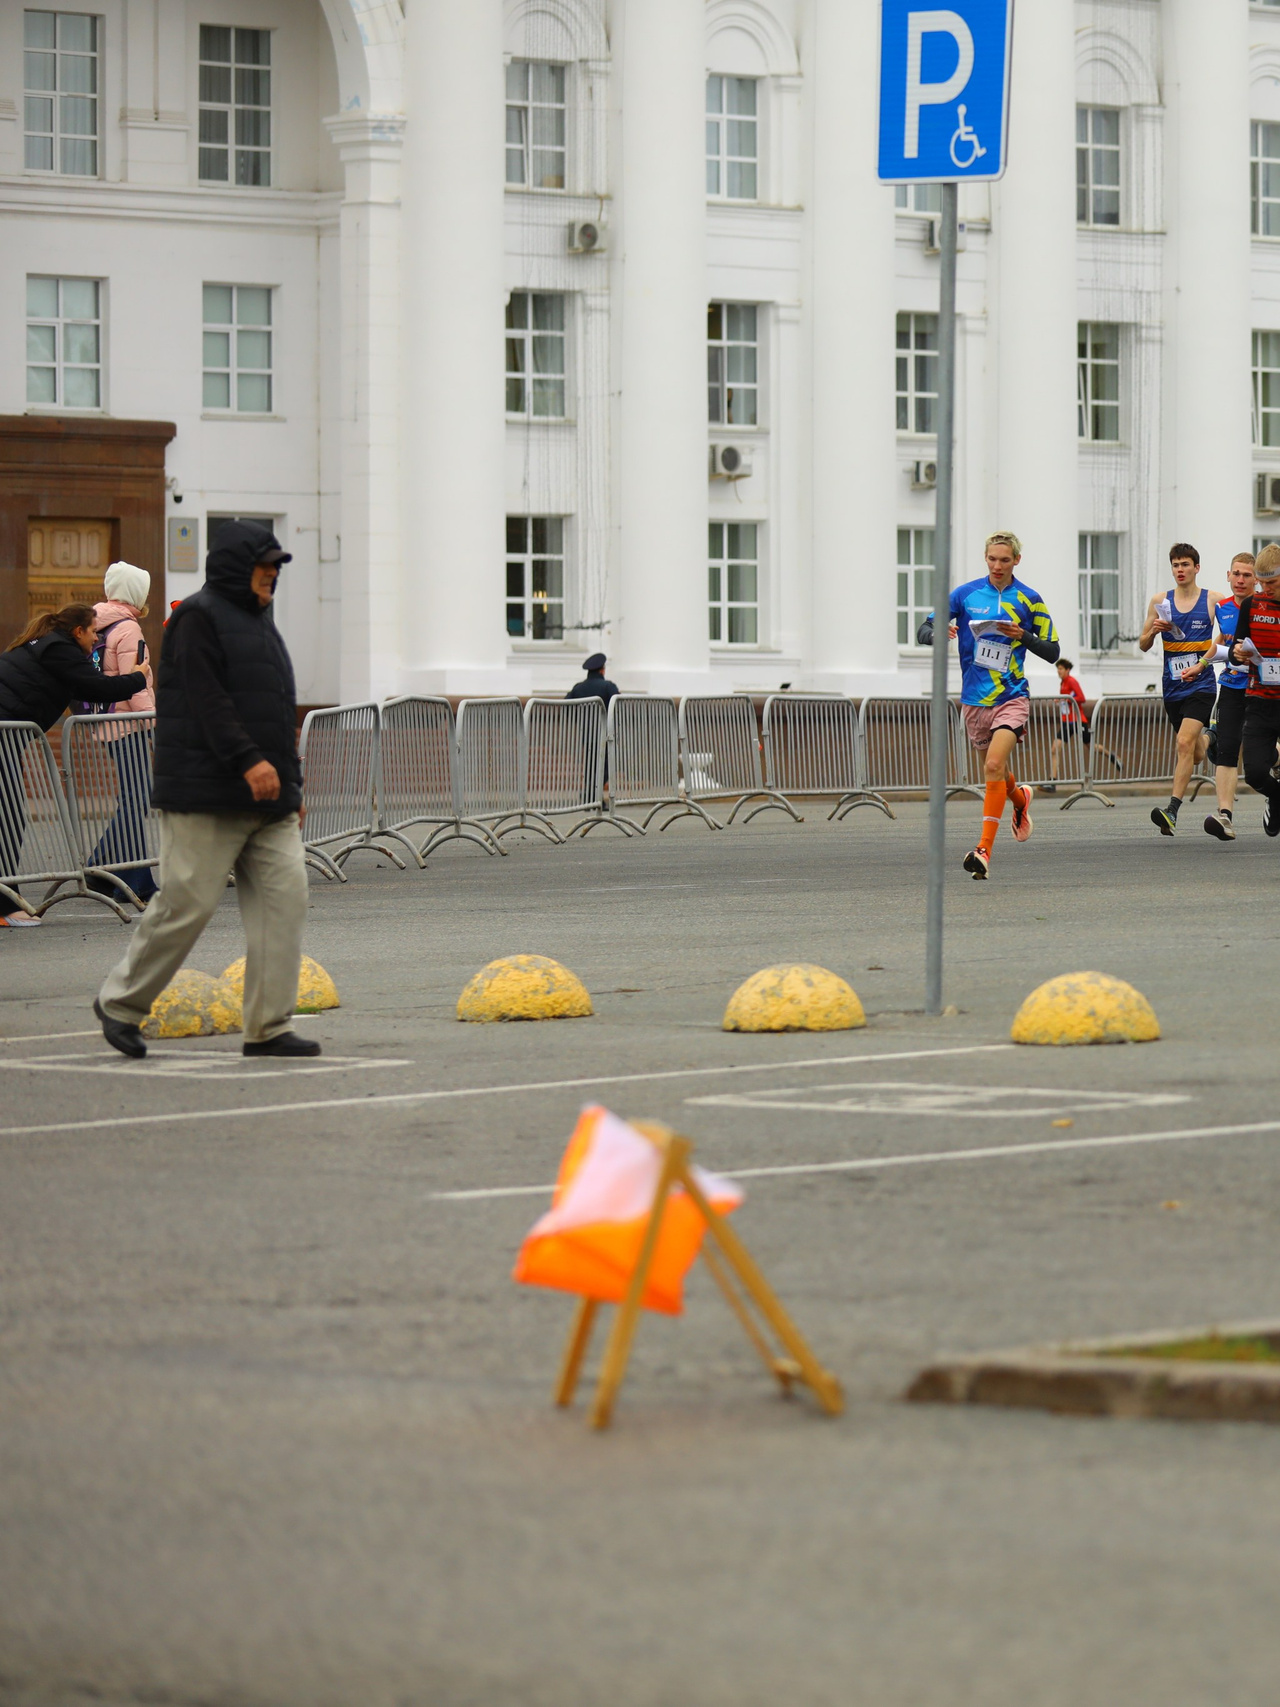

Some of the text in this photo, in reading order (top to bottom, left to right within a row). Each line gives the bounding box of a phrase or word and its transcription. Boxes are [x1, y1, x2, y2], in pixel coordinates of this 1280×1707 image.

[903, 9, 975, 159] P
[1253, 614, 1275, 624] NORD
[981, 647, 1000, 660] 11.1
[1174, 661, 1191, 671] 10.1
